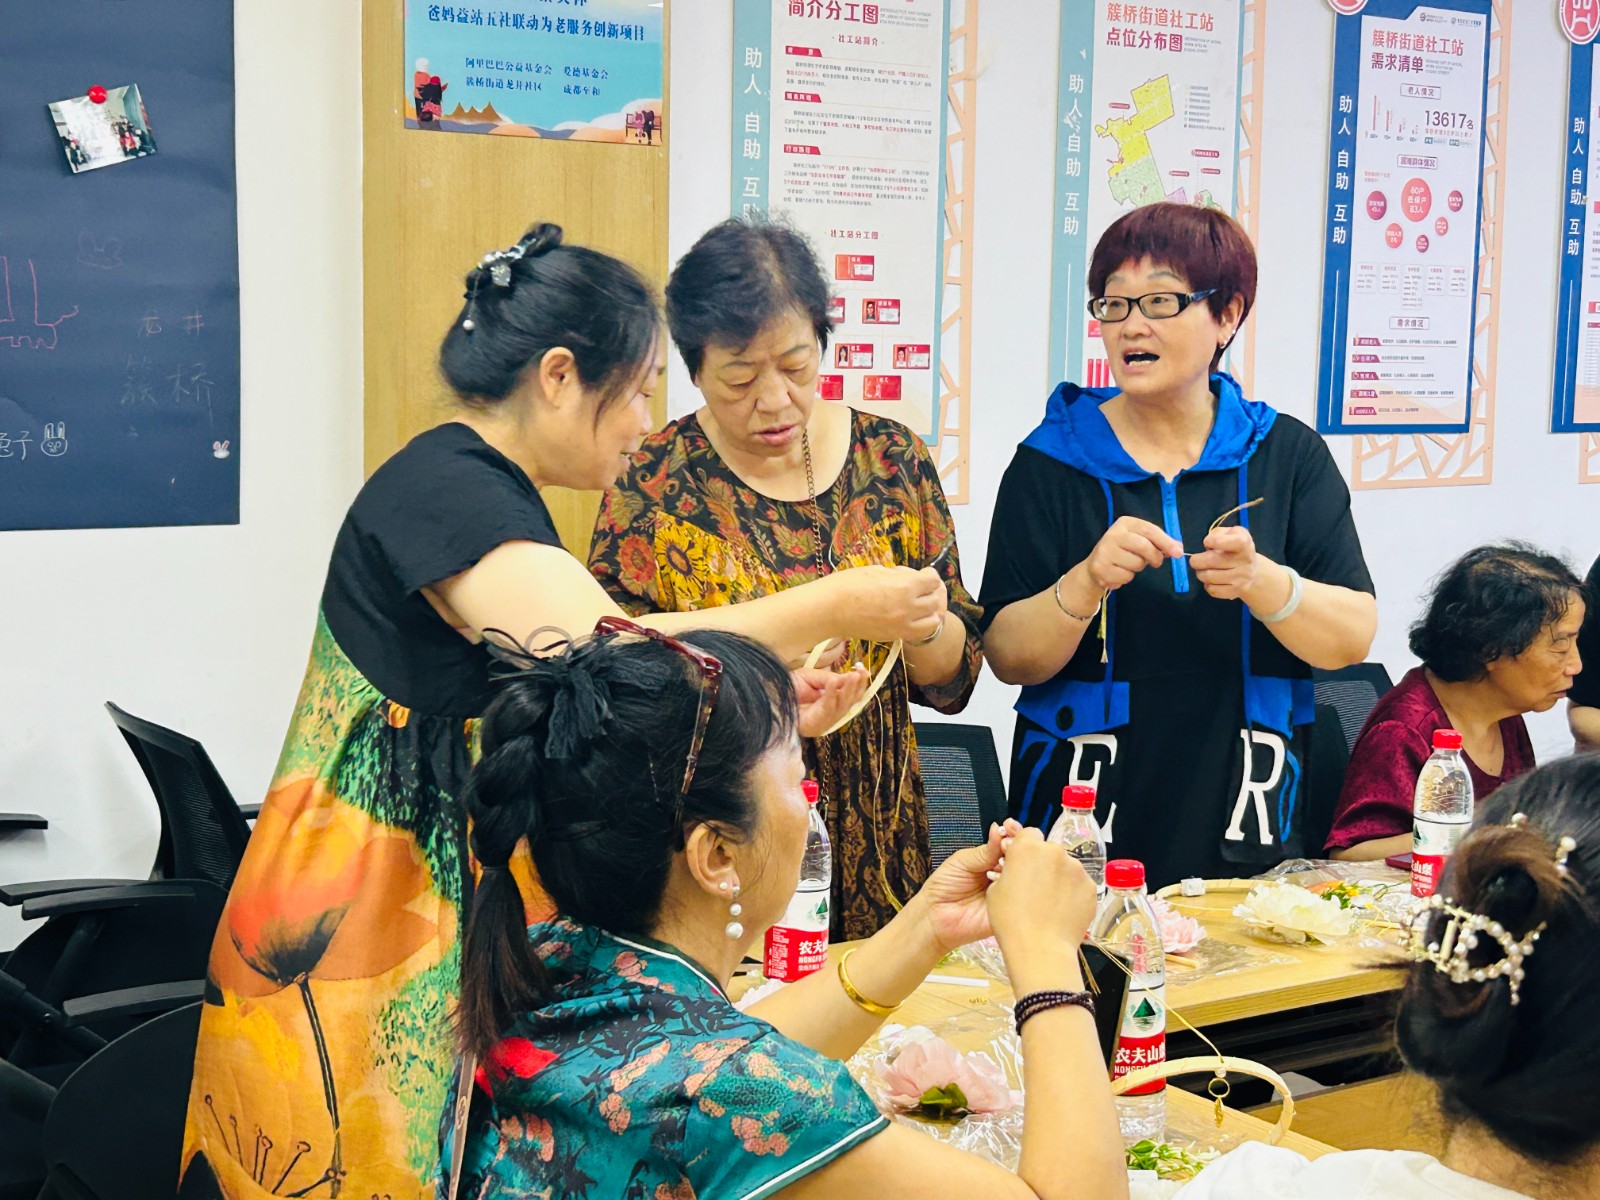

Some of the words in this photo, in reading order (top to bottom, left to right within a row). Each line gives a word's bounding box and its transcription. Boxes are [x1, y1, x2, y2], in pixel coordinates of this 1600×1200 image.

[427, 4, 645, 41] 爸妈益站五社联动为老服务创新项目
[1107, 2, 1214, 32] 簇桥街道社工站
[1106, 27, 1183, 52] 点位分布图
[1372, 29, 1464, 57] 簇桥街道社工站
[465, 57, 552, 76] 阿里巴巴公益基金会
[744, 47, 762, 95] 助人
[1371, 52, 1424, 74] 需求清单
[1068, 74, 1084, 119] 助人
[1338, 95, 1352, 136] 助人
[743, 112, 761, 160] 自助
[1065, 133, 1081, 177] 自助
[1572, 117, 1585, 155] 助人
[1335, 149, 1349, 190] 自助
[1570, 167, 1582, 206] 自助
[1063, 192, 1080, 236] 互助
[1332, 204, 1348, 244] 互助
[1567, 218, 1580, 256] 互助
